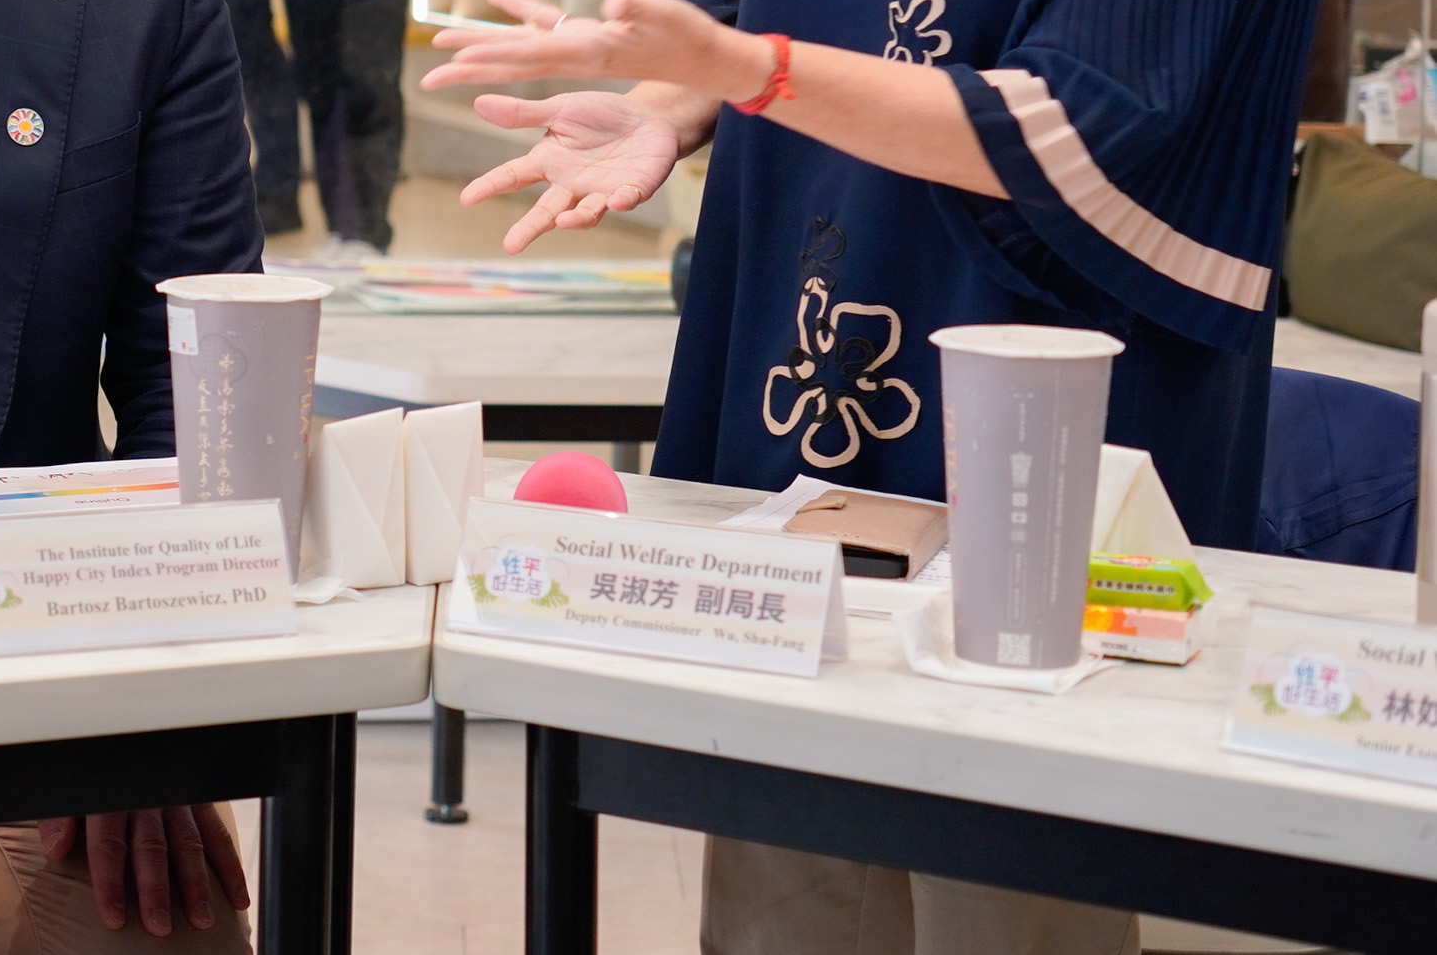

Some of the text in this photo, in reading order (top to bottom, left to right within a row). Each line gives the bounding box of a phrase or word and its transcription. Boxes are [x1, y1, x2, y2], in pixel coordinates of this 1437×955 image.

[36, 534, 263, 562] The Institute for Quality of Life
[554, 536, 823, 585] Social Welfare Department
[23, 555, 281, 589] Happy City Index Program Director
[46, 586, 268, 618] Bartosz Bartoszewicz, PhD
[589, 573, 787, 624] 吳淑芳 副局長
[564, 607, 609, 628] Deputy
[612, 614, 701, 638] Commissioner
[1357, 639, 1426, 668] Social
